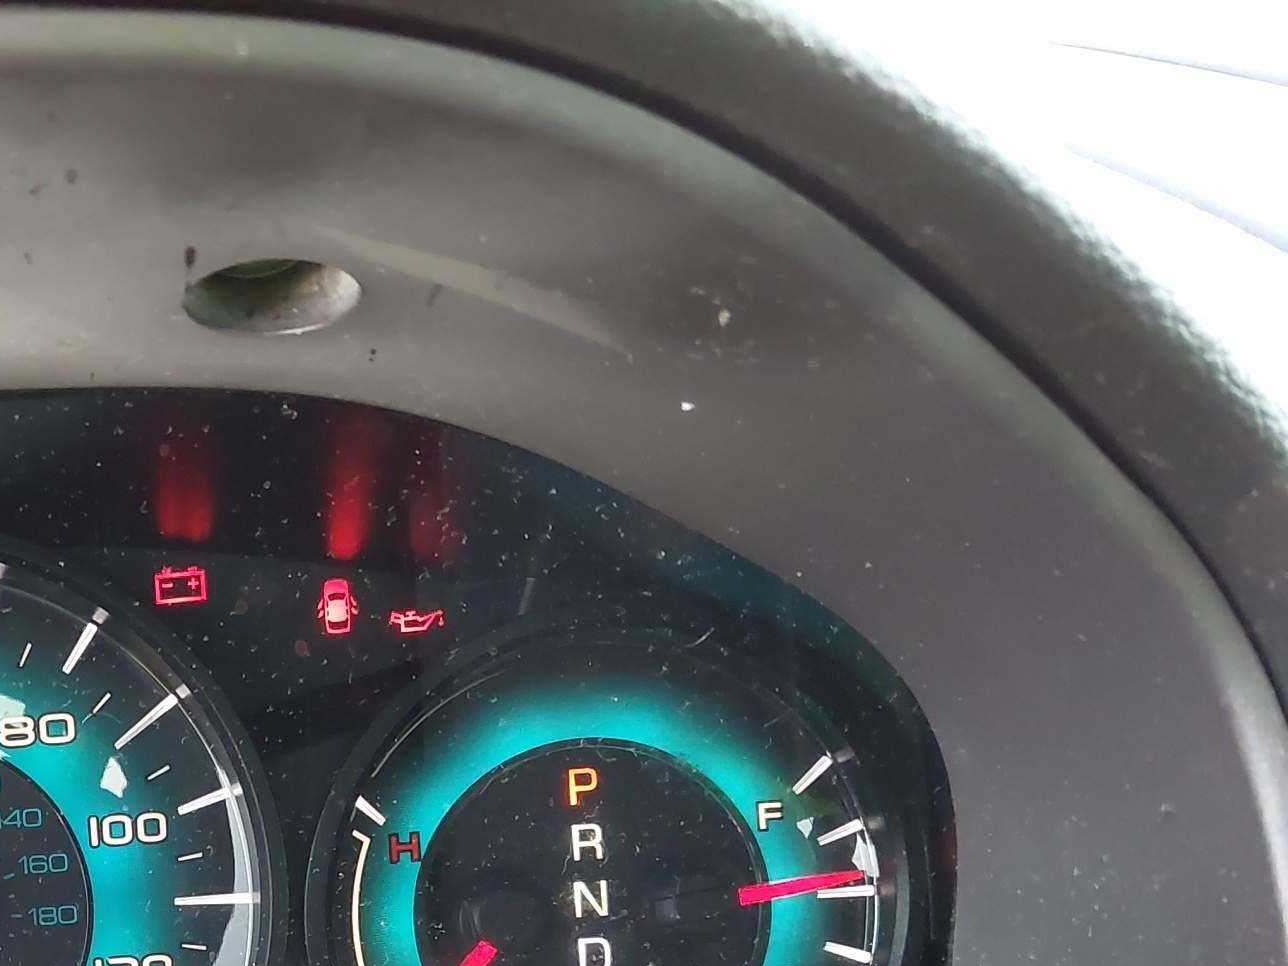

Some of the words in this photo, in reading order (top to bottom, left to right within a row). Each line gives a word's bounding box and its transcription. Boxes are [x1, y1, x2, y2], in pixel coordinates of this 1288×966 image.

[567, 767, 598, 806] P
[88, 813, 168, 847] 100
[755, 802, 783, 831] F
[388, 832, 422, 863] H
[571, 823, 604, 861] R
[20, 852, 69, 874] 160
[28, 904, 78, 926] 180
[573, 881, 609, 918] N
